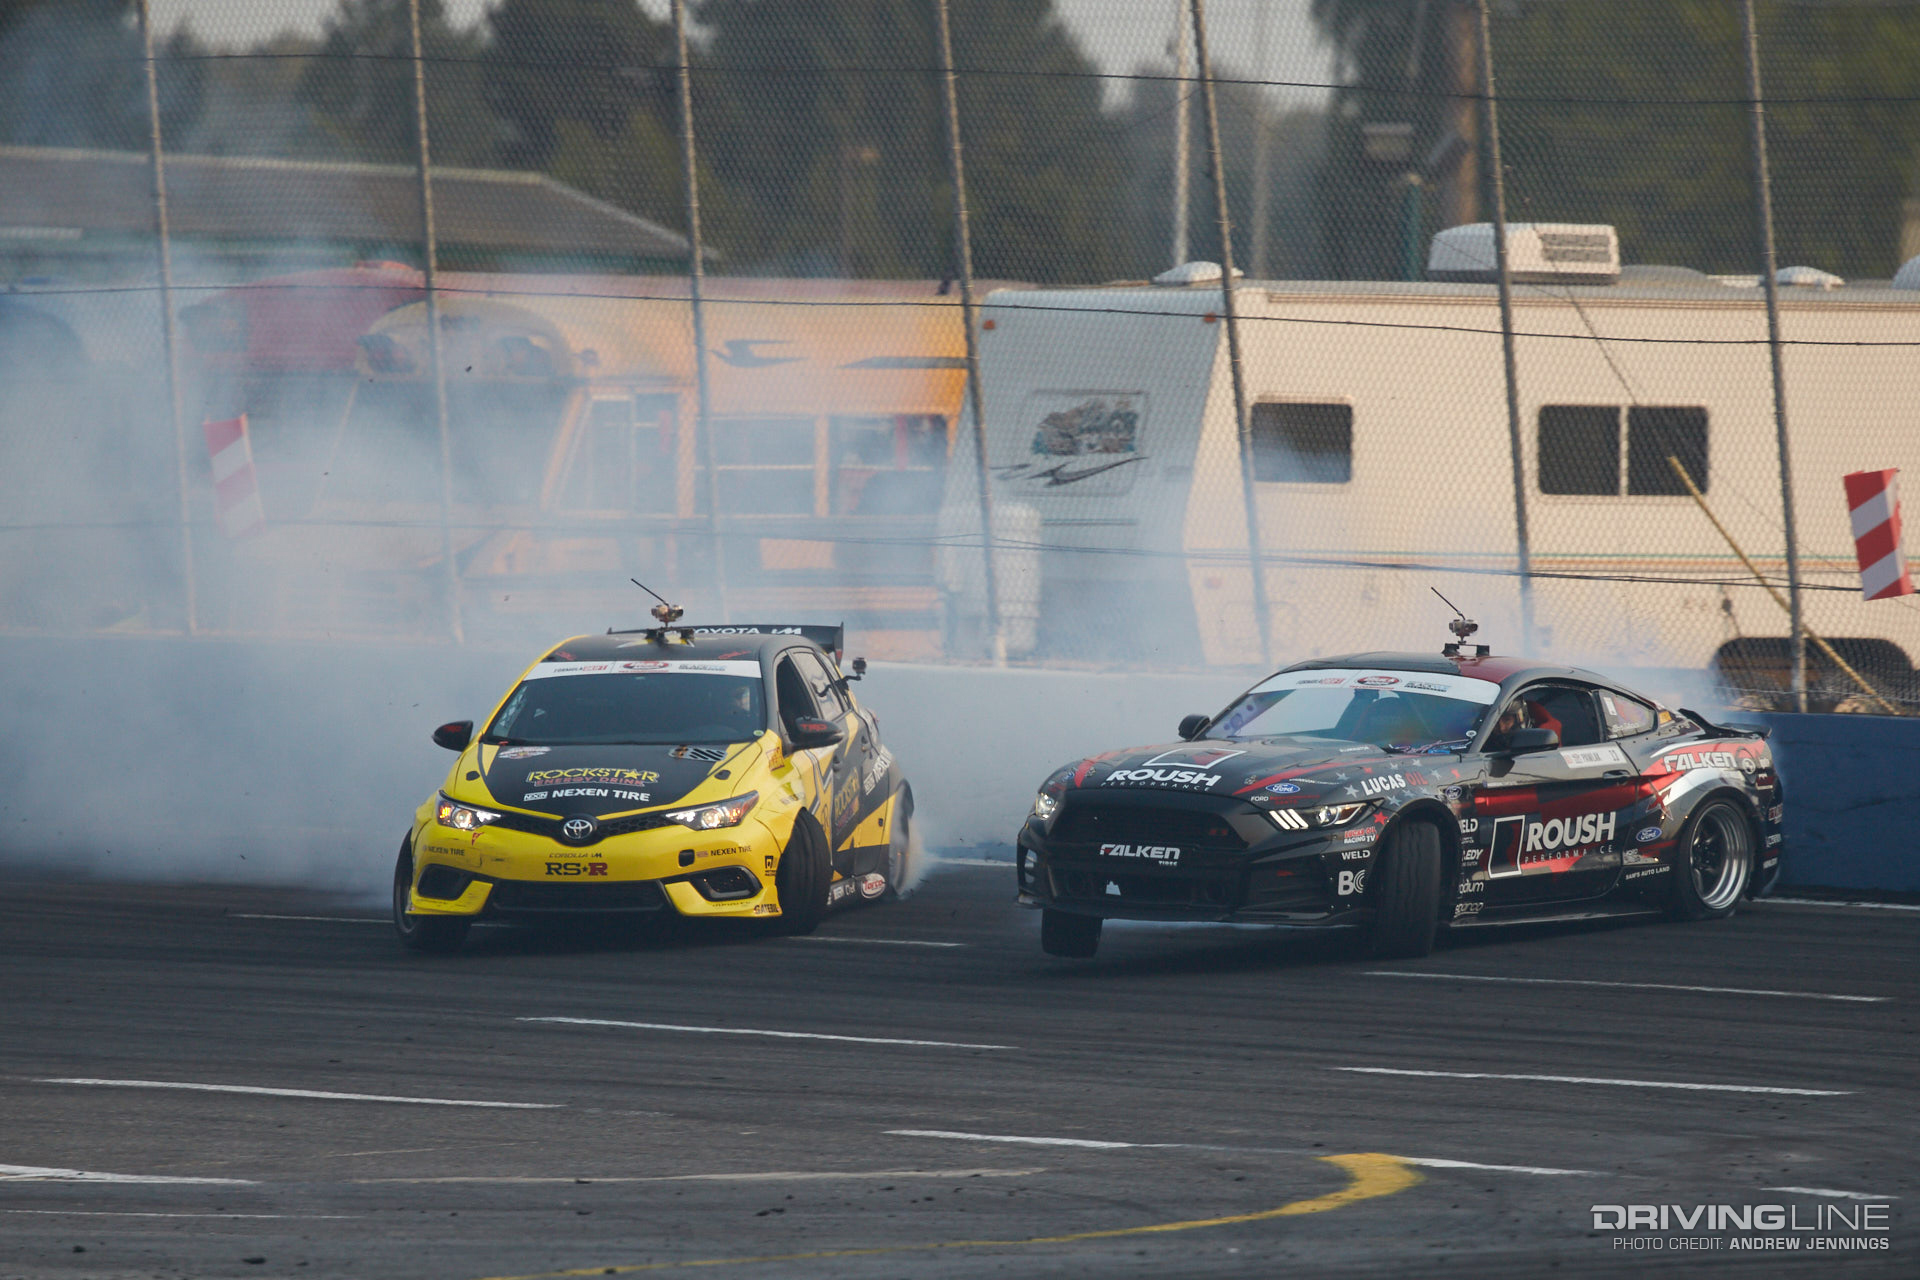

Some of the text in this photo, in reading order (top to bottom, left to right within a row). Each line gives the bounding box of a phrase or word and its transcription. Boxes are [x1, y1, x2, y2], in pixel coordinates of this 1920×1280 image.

[1663, 751, 1738, 773] FALKEN
[529, 767, 659, 783] ROCKSTAR
[1106, 768, 1222, 787] ROUSH
[1100, 780, 1211, 792] PERFORMANCE
[1360, 771, 1429, 796] LUCAS OIL
[552, 788, 609, 799] NEXEN
[614, 789, 651, 802] TIRE
[1526, 811, 1616, 852] ROUSH
[450, 847, 465, 857] TIRE
[711, 847, 737, 857] NEXEN
[738, 845, 752, 853] TIRE
[1099, 843, 1181, 860] FALKEN
[1341, 849, 1371, 861] WELD
[1524, 844, 1613, 864] PERFORMACE
[1641, 868, 1655, 877] AUTO
[863, 879, 884, 891] Torco
